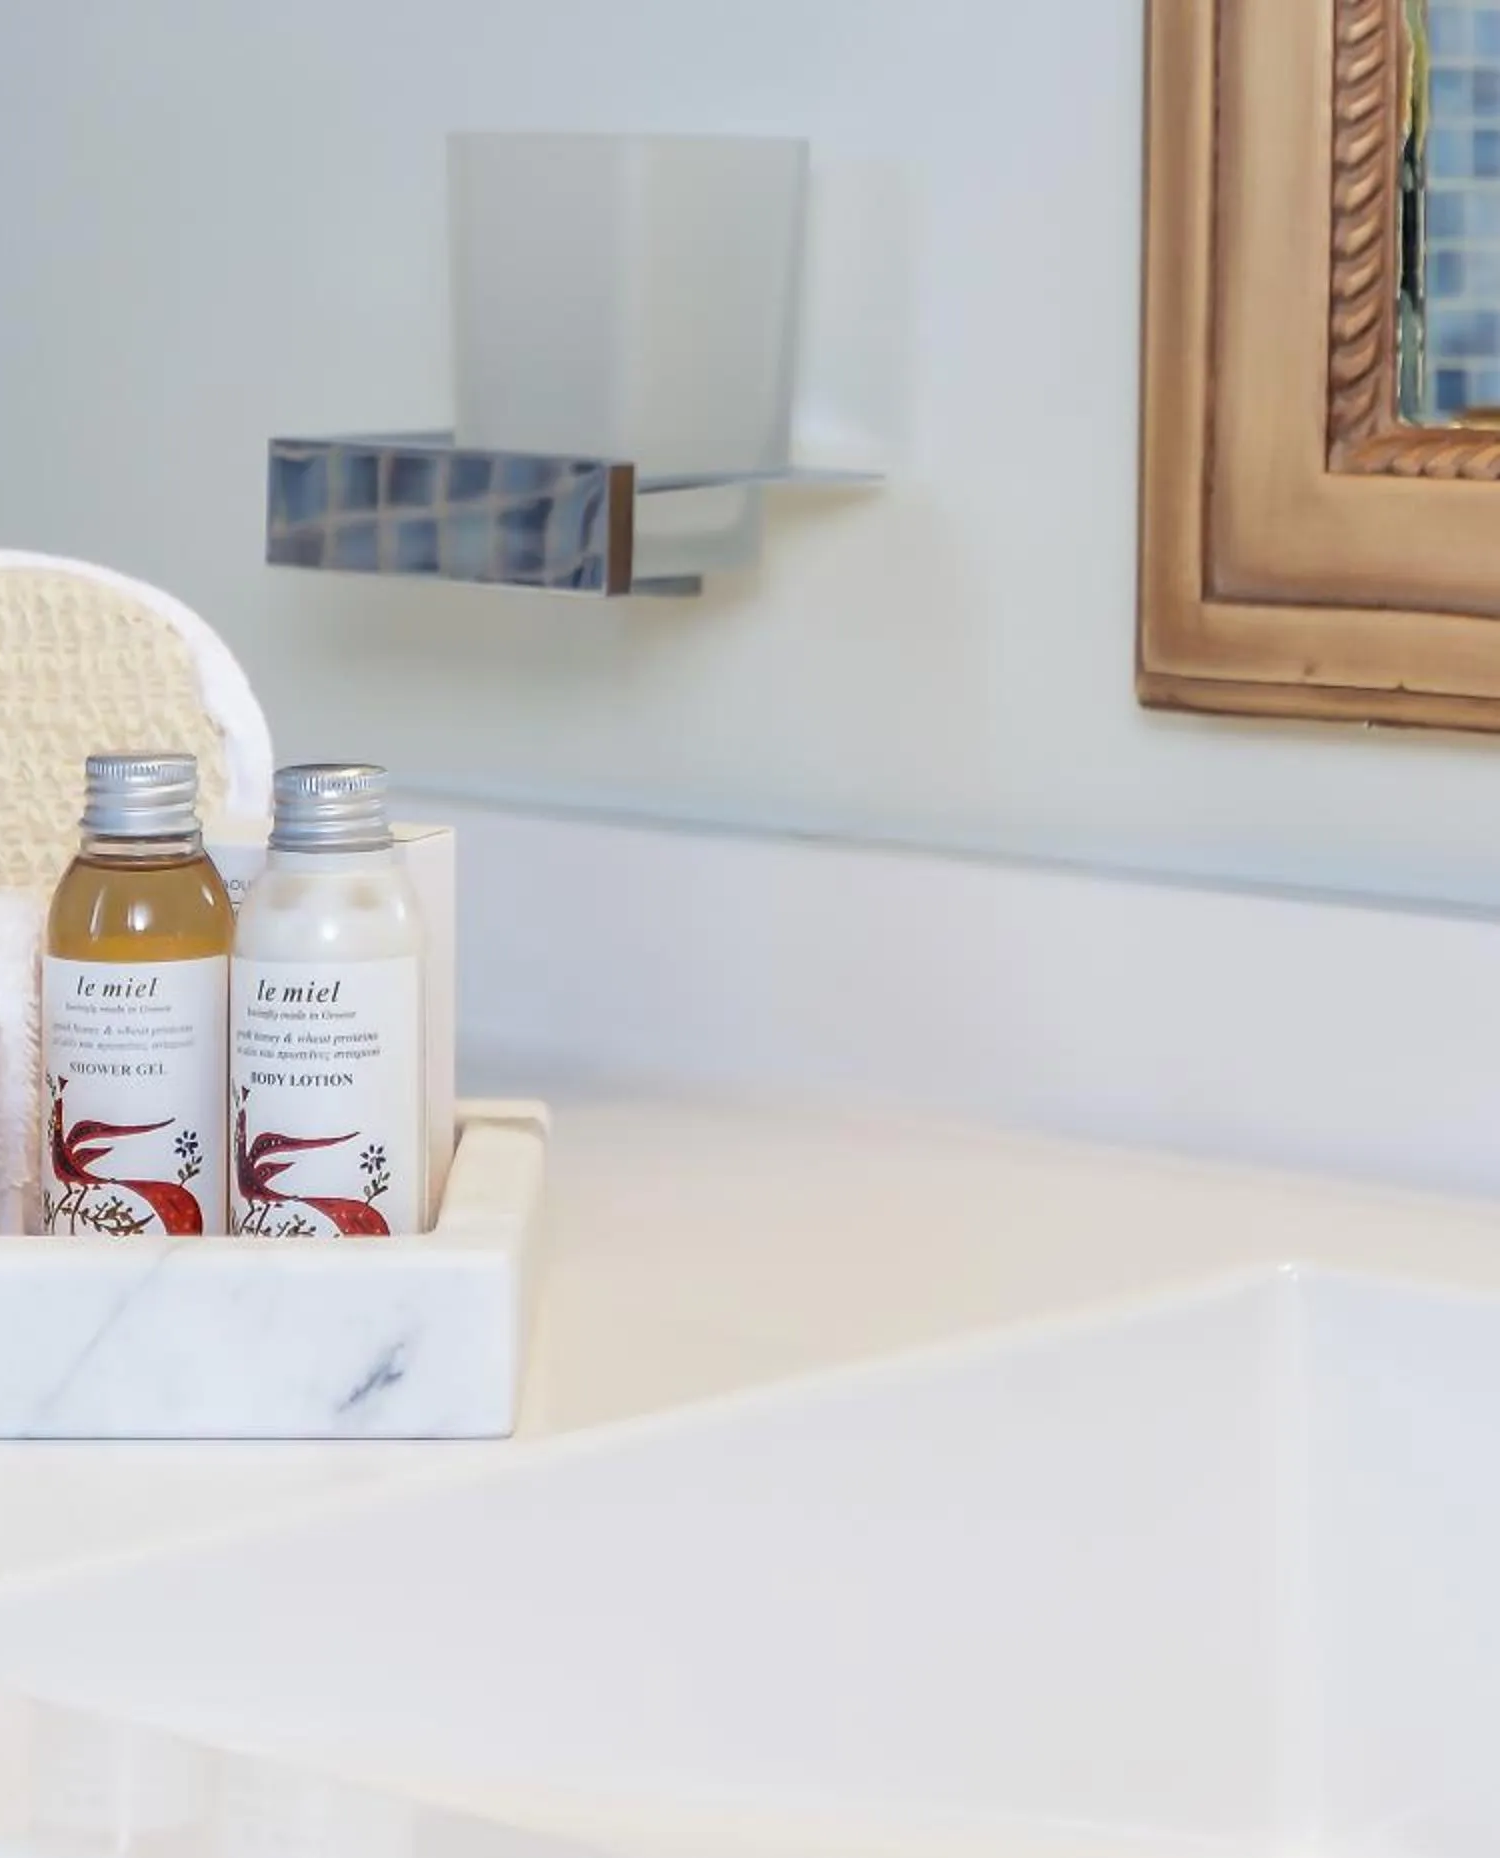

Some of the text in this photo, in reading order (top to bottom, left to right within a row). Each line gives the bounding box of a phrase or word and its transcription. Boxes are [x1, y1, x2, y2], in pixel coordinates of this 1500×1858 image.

[76, 975, 157, 998] le miel
[257, 979, 341, 1003] le miel
[69, 1061, 167, 1076] SHOWER GEL
[250, 1071, 353, 1087] BODY LOTION
